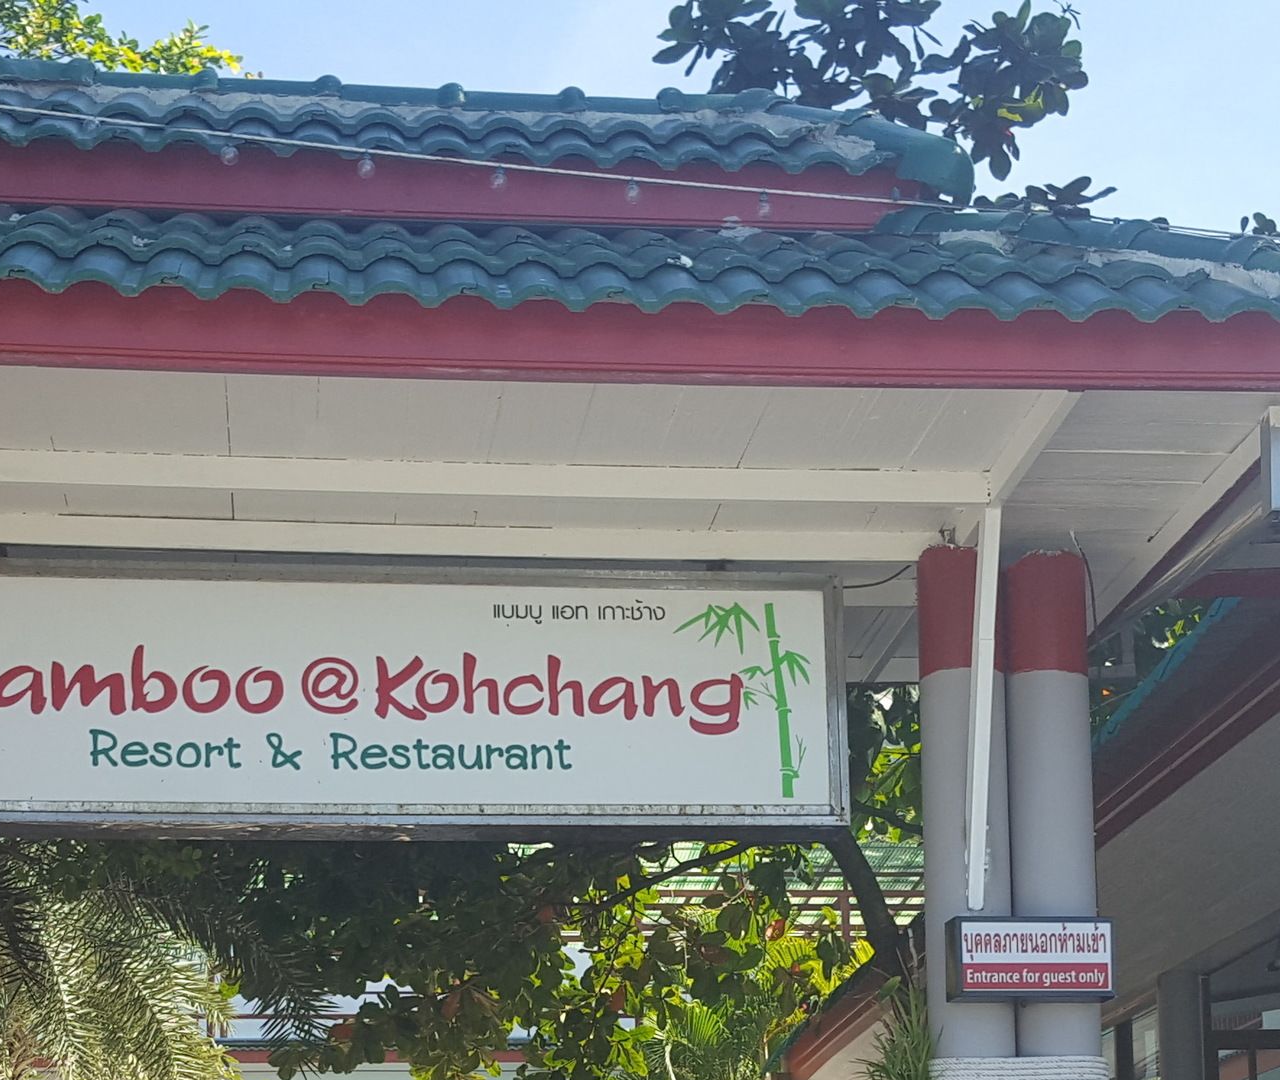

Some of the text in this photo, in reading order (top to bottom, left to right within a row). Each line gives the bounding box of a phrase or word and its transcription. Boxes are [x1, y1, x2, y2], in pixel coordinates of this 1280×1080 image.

[493, 599, 666, 625] แบมบู แอท เกาะช้าง
[301, 656, 361, 717] @
[374, 652, 746, 737] Kohchang
[89, 728, 575, 773] Resort & Restaurant
[963, 922, 1107, 961] บุคคลภายนอกห้ามเข้า
[966, 968, 1106, 987] Entrance for guest only
